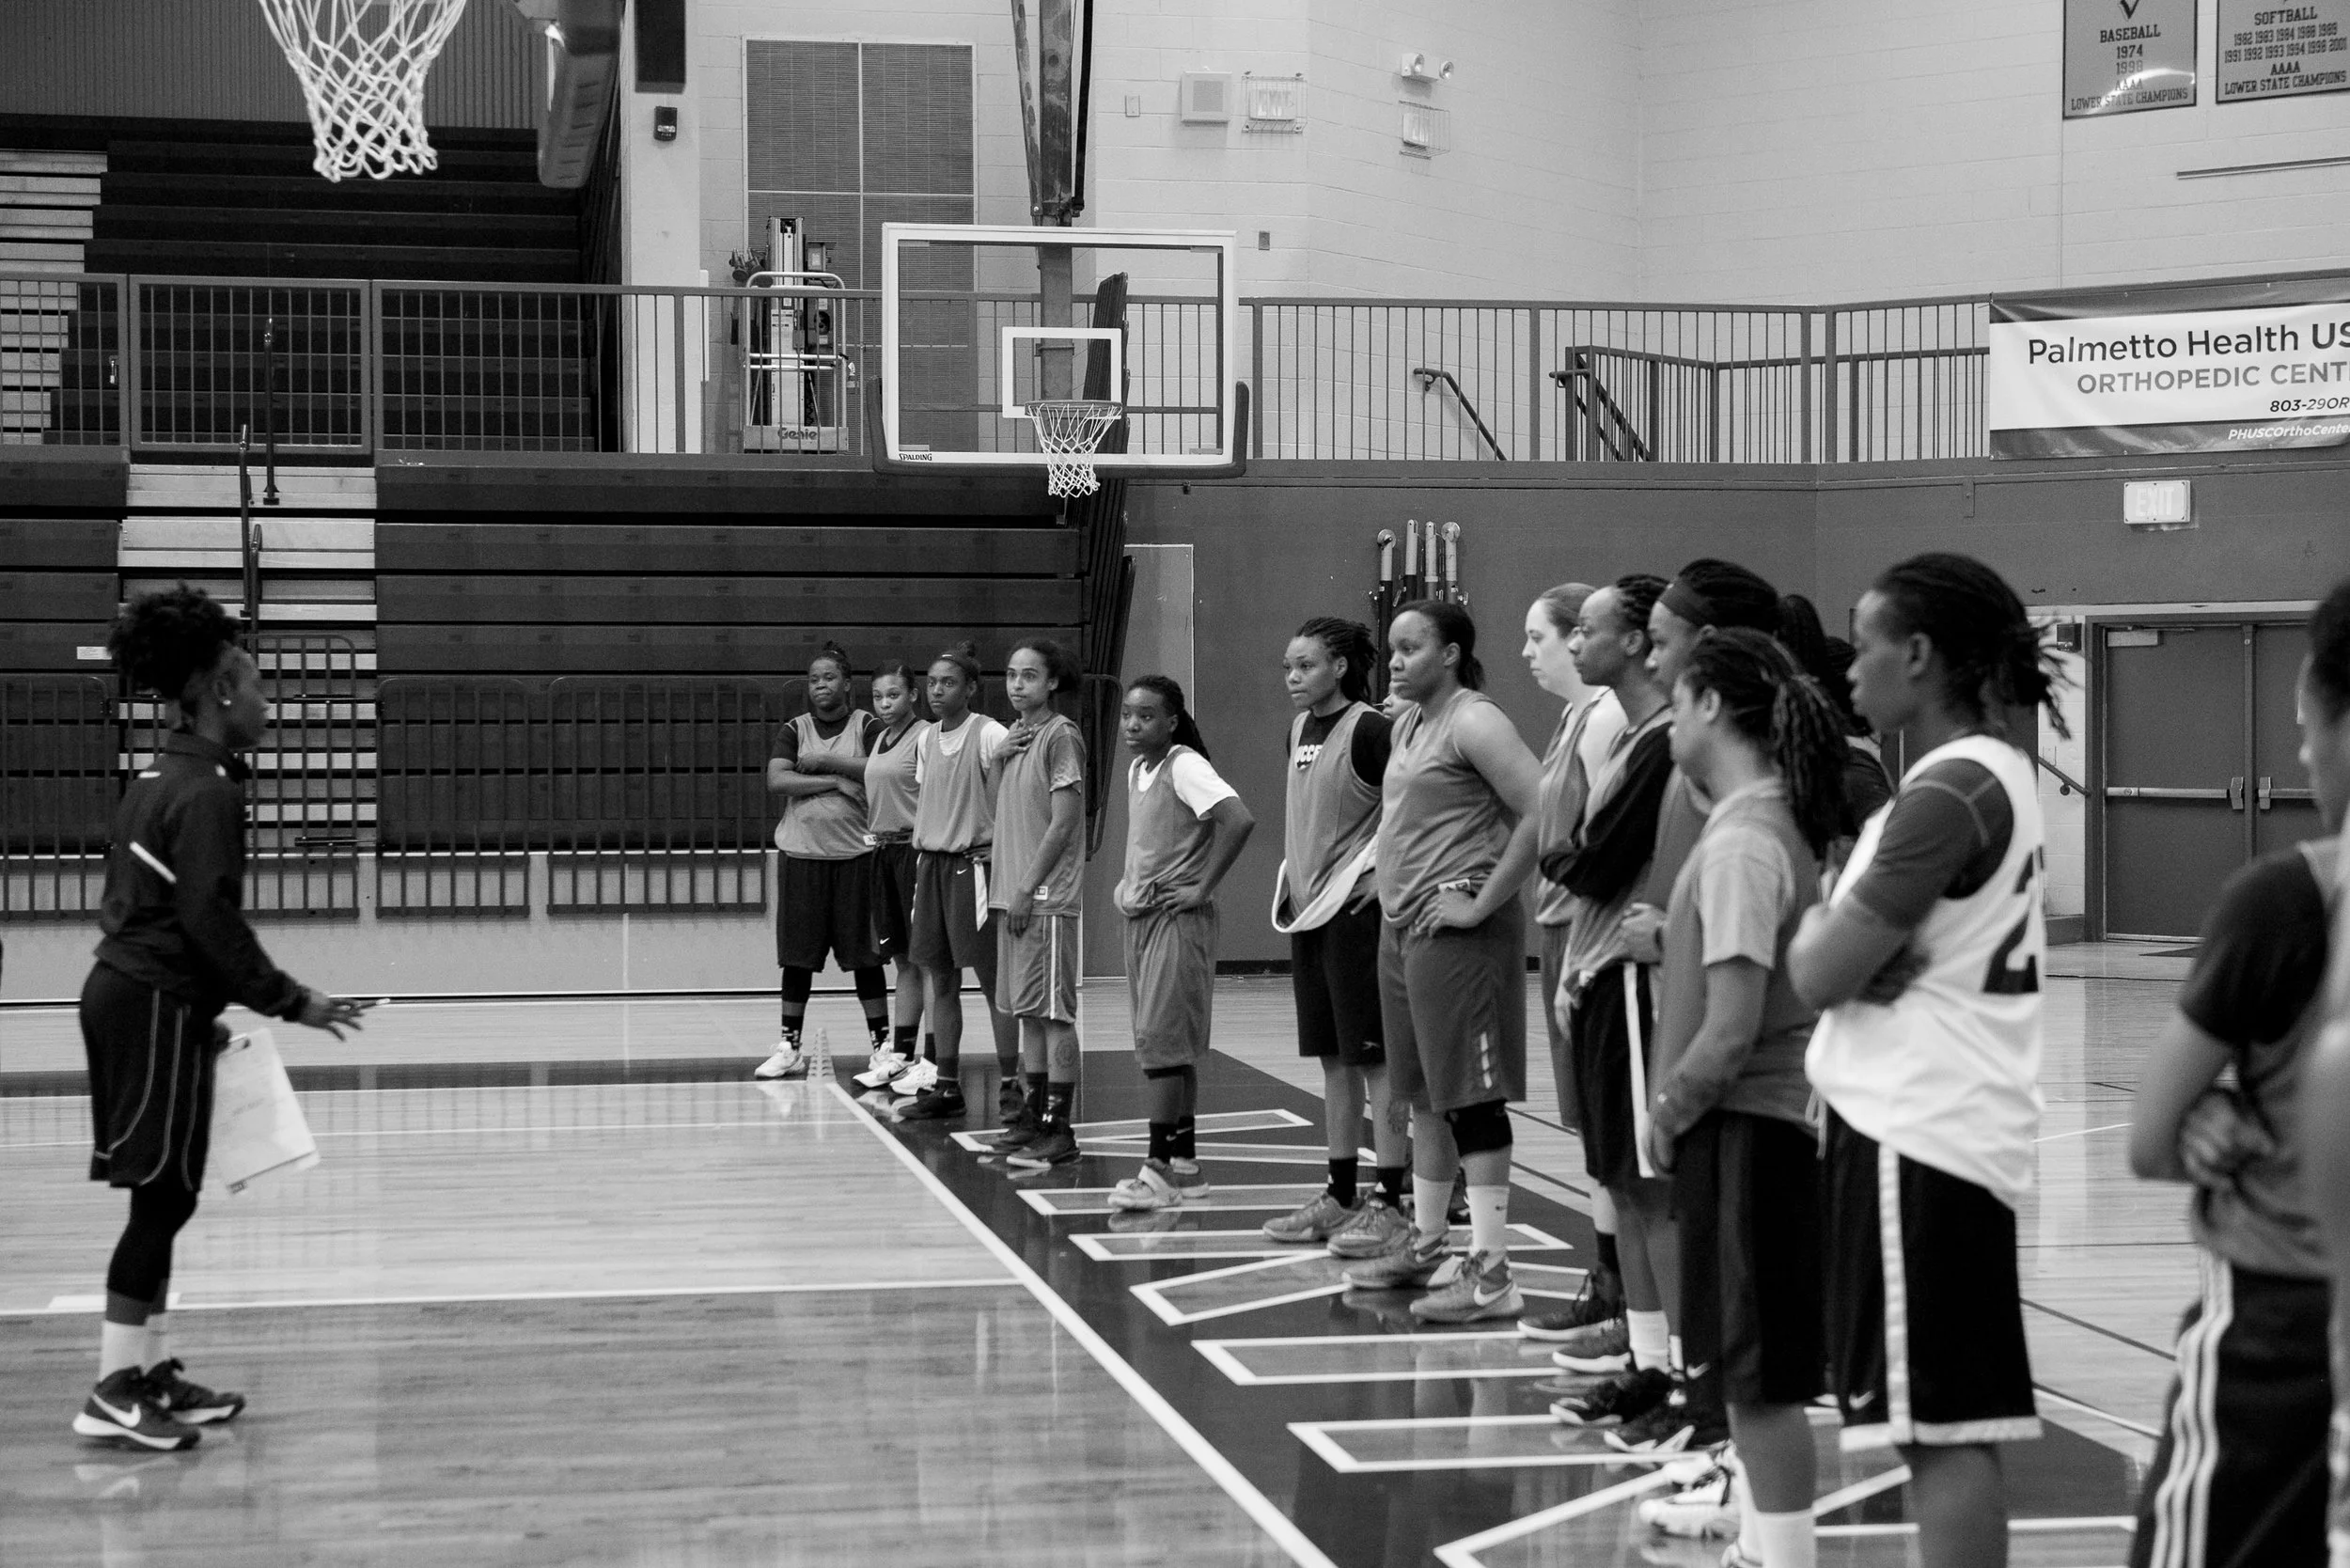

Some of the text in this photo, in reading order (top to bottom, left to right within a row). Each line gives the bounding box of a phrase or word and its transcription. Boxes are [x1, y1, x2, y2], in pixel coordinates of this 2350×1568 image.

[2254, 6, 2318, 25] SOFTBALL
[2099, 24, 2161, 43] BASEBALL
[2233, 32, 2253, 47] 1982
[2255, 29, 2274, 44] 1983
[2276, 26, 2295, 42] 1984
[2116, 44, 2143, 59] 1974
[2224, 48, 2242, 64] 1991
[2244, 46, 2263, 61] 1992
[2264, 44, 2284, 59] 1993
[2286, 41, 2306, 56] 1994
[2270, 60, 2300, 75] AAAA
[2114, 78, 2143, 91] AAAA
[2224, 71, 2347, 95] LOWER STATE CHAMPIONS
[2071, 87, 2188, 111] LOWER STATE CHAMPIONS
[2029, 334, 2177, 365] Palmetto
[2187, 324, 2298, 357] Health
[2077, 361, 2350, 394] ORTHOPEDIC CENT
[777, 427, 818, 440] Genie
[2228, 423, 2350, 441] PHUSCOrthoCente
[2135, 486, 2175, 517] EXIT
